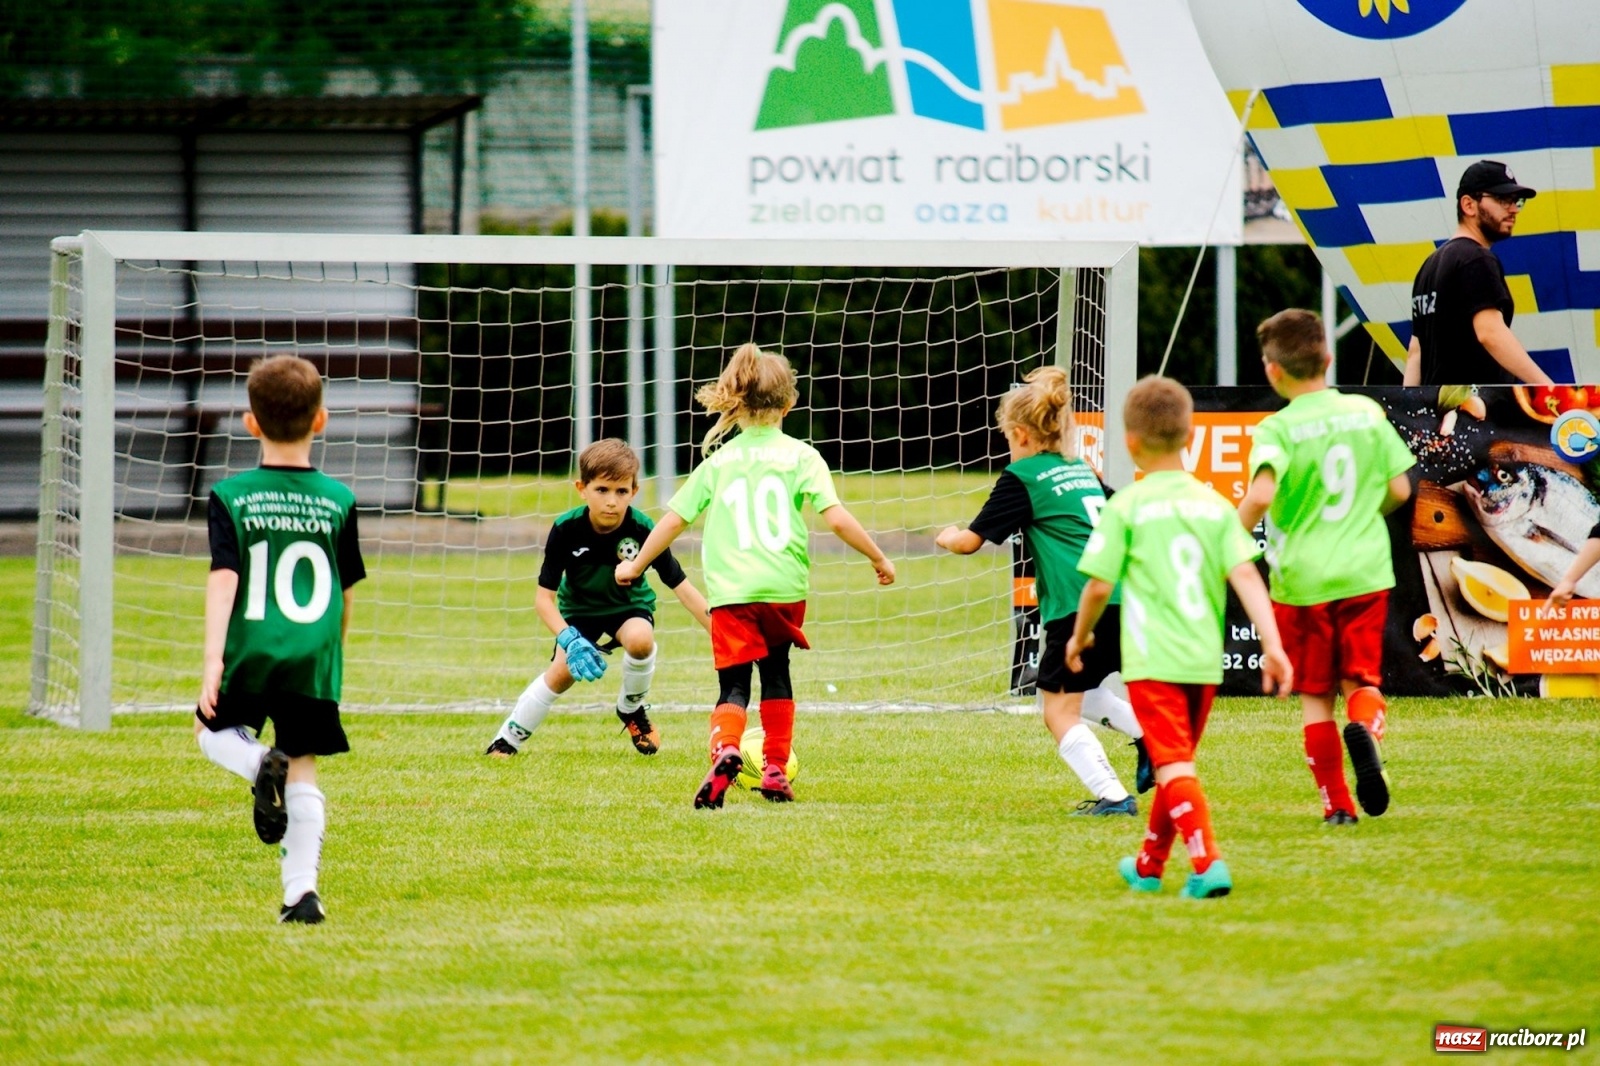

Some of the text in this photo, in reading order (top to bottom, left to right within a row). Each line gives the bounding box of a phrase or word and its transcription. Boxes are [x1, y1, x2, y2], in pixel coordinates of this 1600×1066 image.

[749, 142, 1150, 194] powiat raciborski
[749, 197, 1151, 224] zielona oaza kultur
[1321, 443, 1357, 523] 9
[241, 513, 333, 535] TWORKÓW
[721, 475, 791, 552] 10
[244, 540, 332, 624] 10
[1169, 533, 1207, 620] 8
[1519, 606, 1600, 620] U NAS RYB
[1231, 623, 1262, 641] tel.
[1524, 627, 1600, 641] Z WŁASNE
[1222, 653, 1243, 670] 32
[1530, 648, 1600, 665] WĘDZARN
